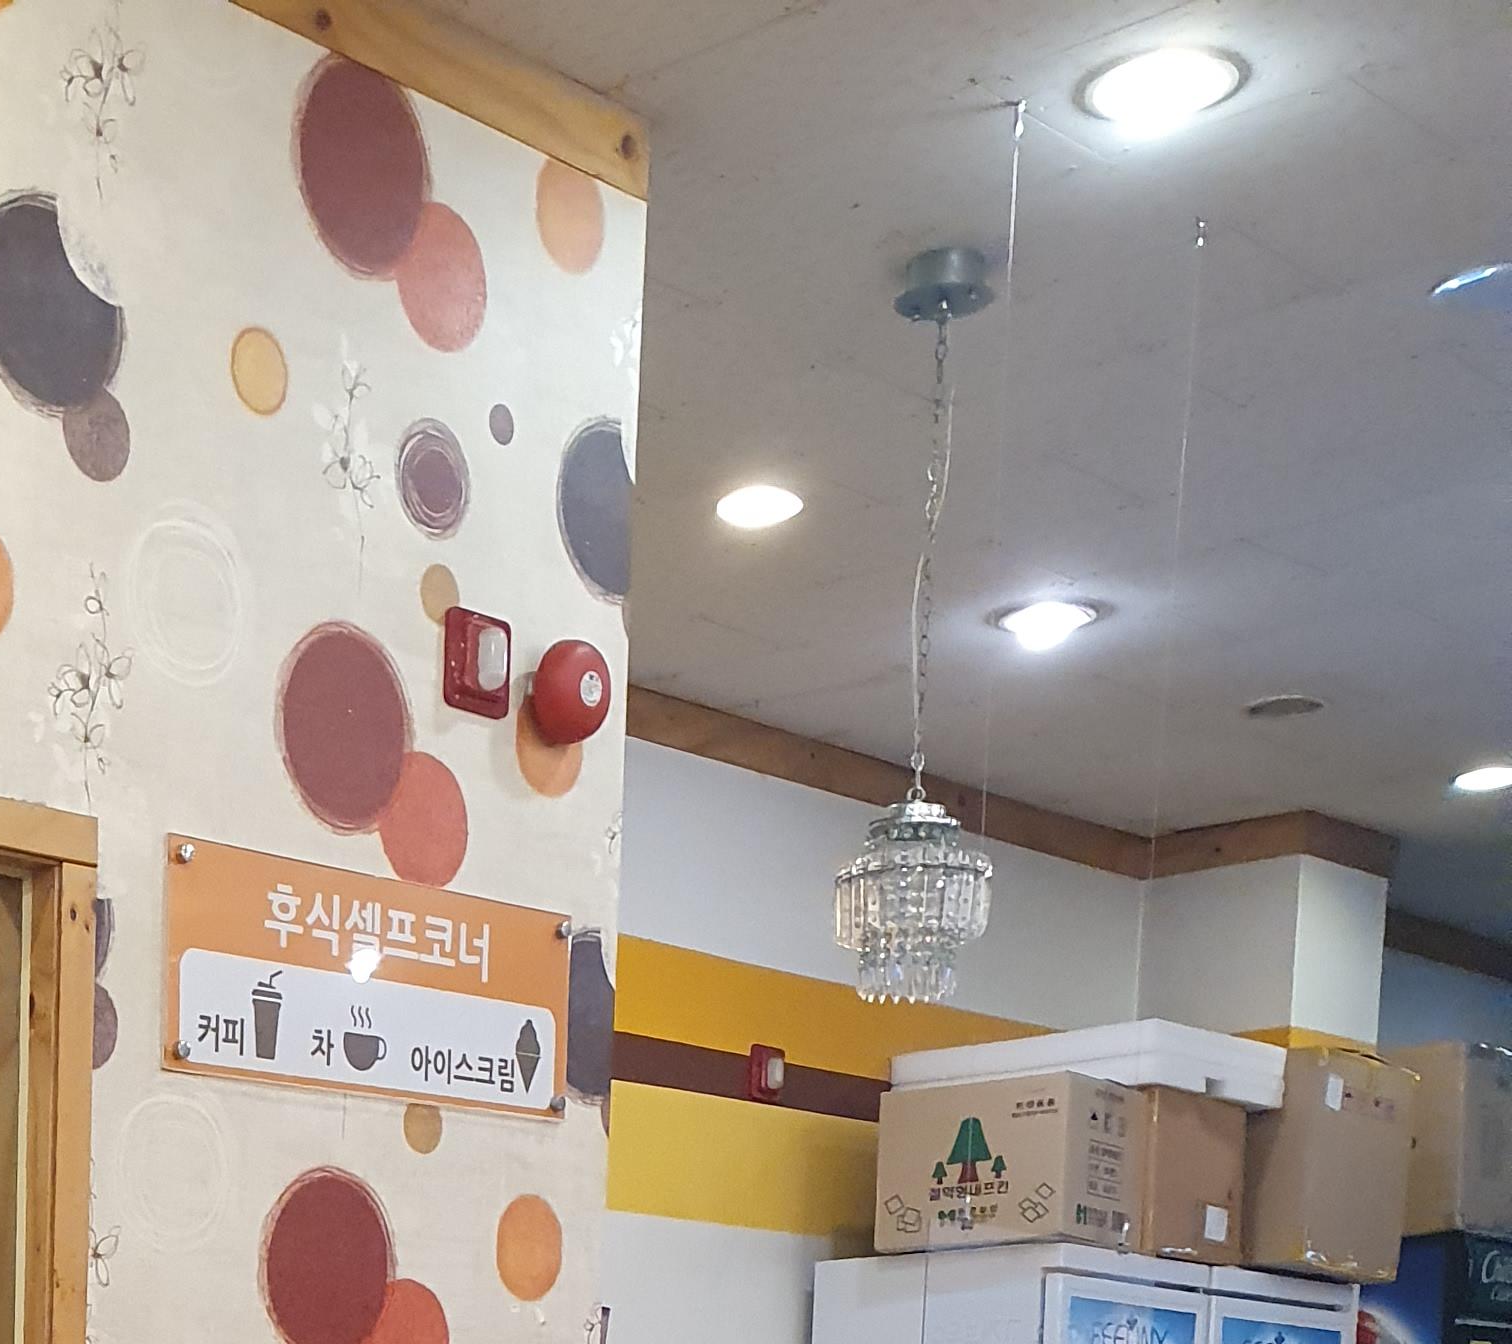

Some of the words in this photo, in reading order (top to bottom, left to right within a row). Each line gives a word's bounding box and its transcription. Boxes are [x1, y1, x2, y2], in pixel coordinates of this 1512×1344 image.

[264, 884, 489, 983] 후식셀프코너
[197, 1014, 245, 1056] 커피
[311, 1028, 335, 1066] 차
[411, 1045, 515, 1094] 아이스크림
